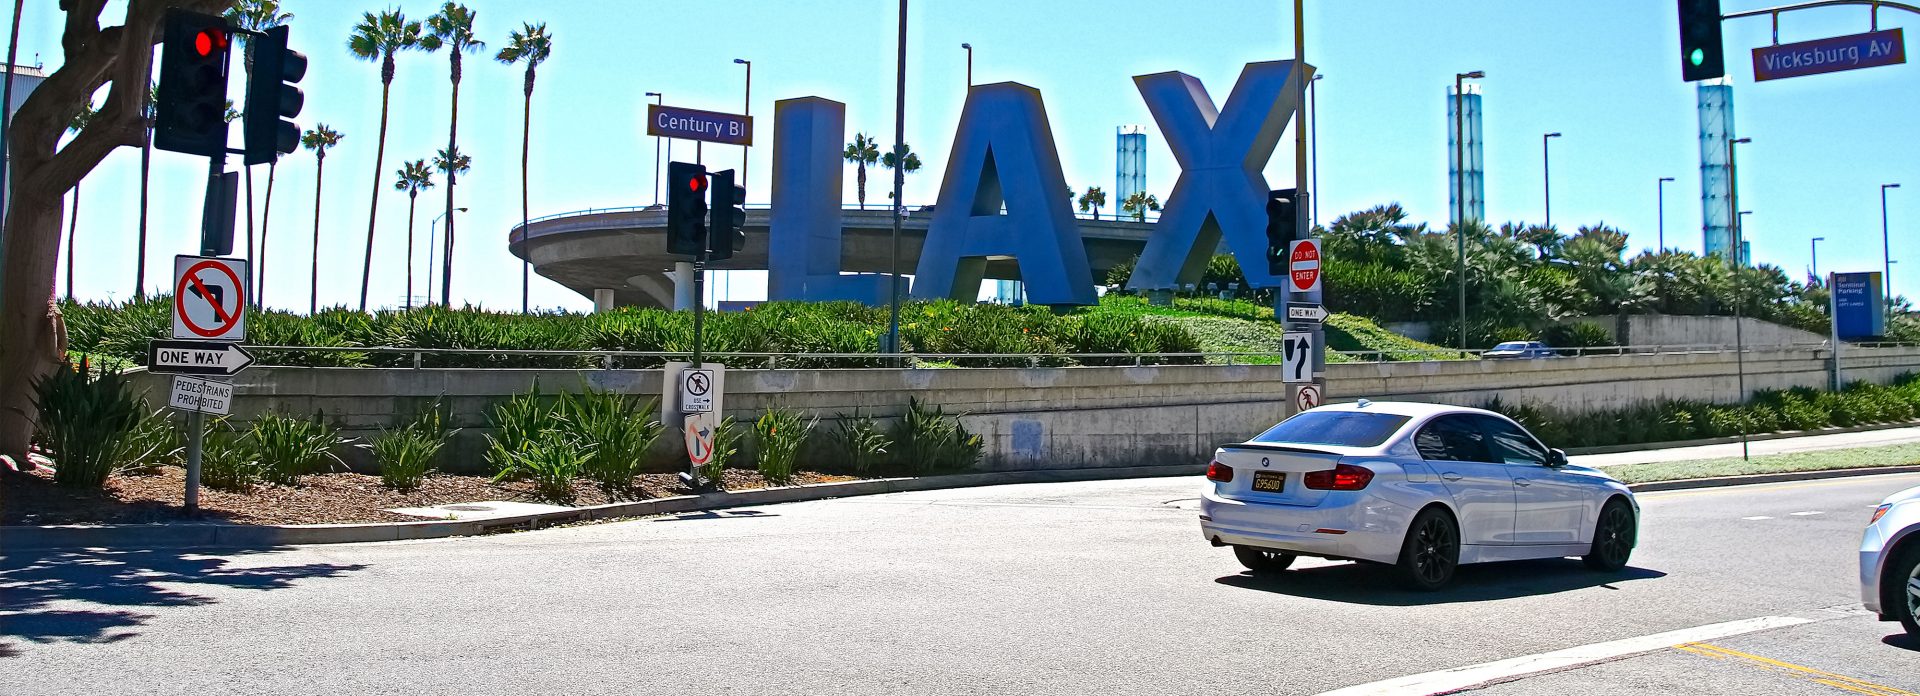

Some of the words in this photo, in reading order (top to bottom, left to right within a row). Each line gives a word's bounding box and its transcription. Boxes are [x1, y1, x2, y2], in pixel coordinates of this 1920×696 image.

[1763, 45, 1858, 71] Vicksburg
[1869, 39, 1893, 57] Av
[658, 112, 723, 138] Century
[729, 121, 744, 137] Bl
[768, 59, 1316, 307] LAX
[1294, 251, 1303, 260] DO
[1304, 249, 1316, 259] NOT
[1295, 271, 1314, 281] ENTER
[1290, 308, 1303, 317] ONE
[1304, 309, 1318, 317] WAY
[160, 350, 189, 364] ONE
[194, 352, 224, 365] WAY
[175, 380, 230, 398] PEDESTRIANS
[176, 393, 223, 410] PROHIBITED
